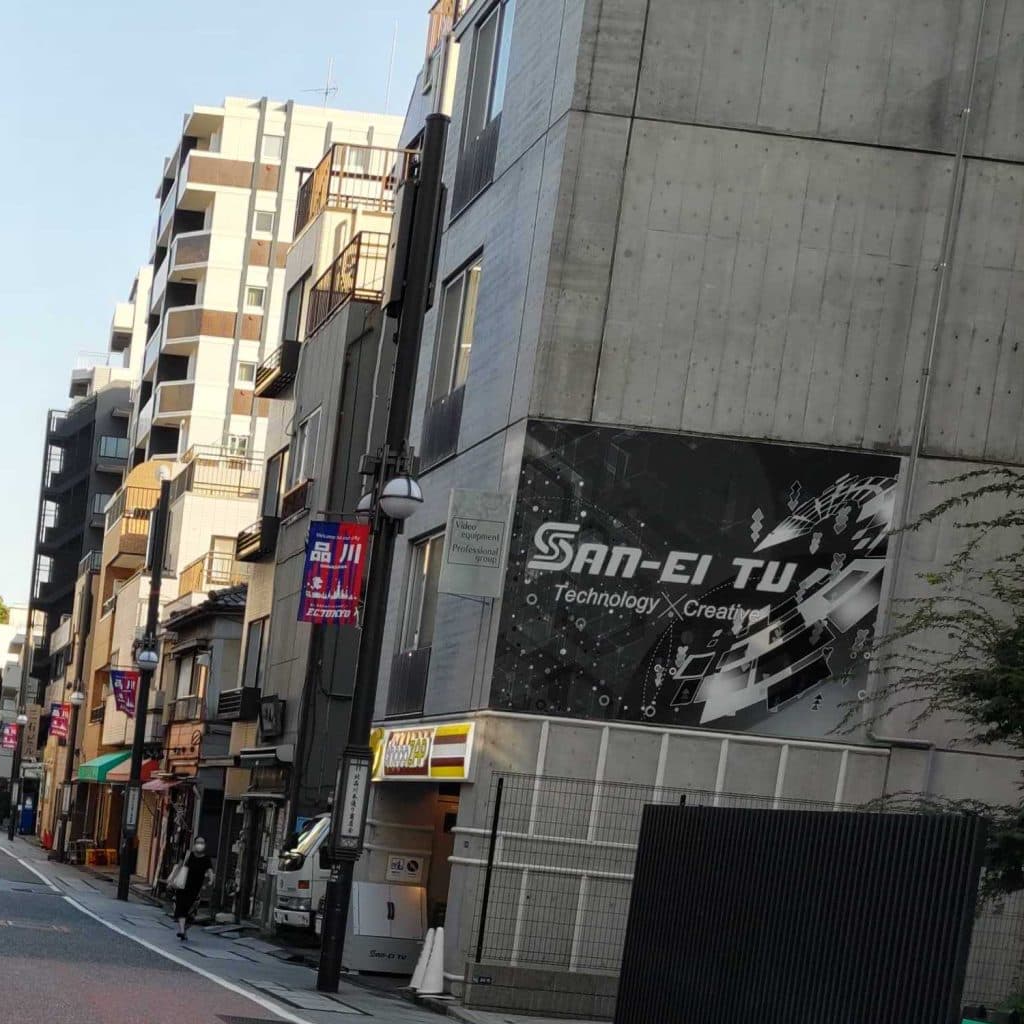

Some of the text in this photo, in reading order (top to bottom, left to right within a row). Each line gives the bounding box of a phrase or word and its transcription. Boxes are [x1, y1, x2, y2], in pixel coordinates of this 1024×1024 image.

[455, 520, 477, 531] Video
[461, 531, 499, 542] equipment
[310, 541, 362, 564] 品川
[452, 543, 499, 556] Professional
[474, 555, 498, 565] group
[553, 583, 661, 615] Technology
[683, 599, 762, 623] Creative
